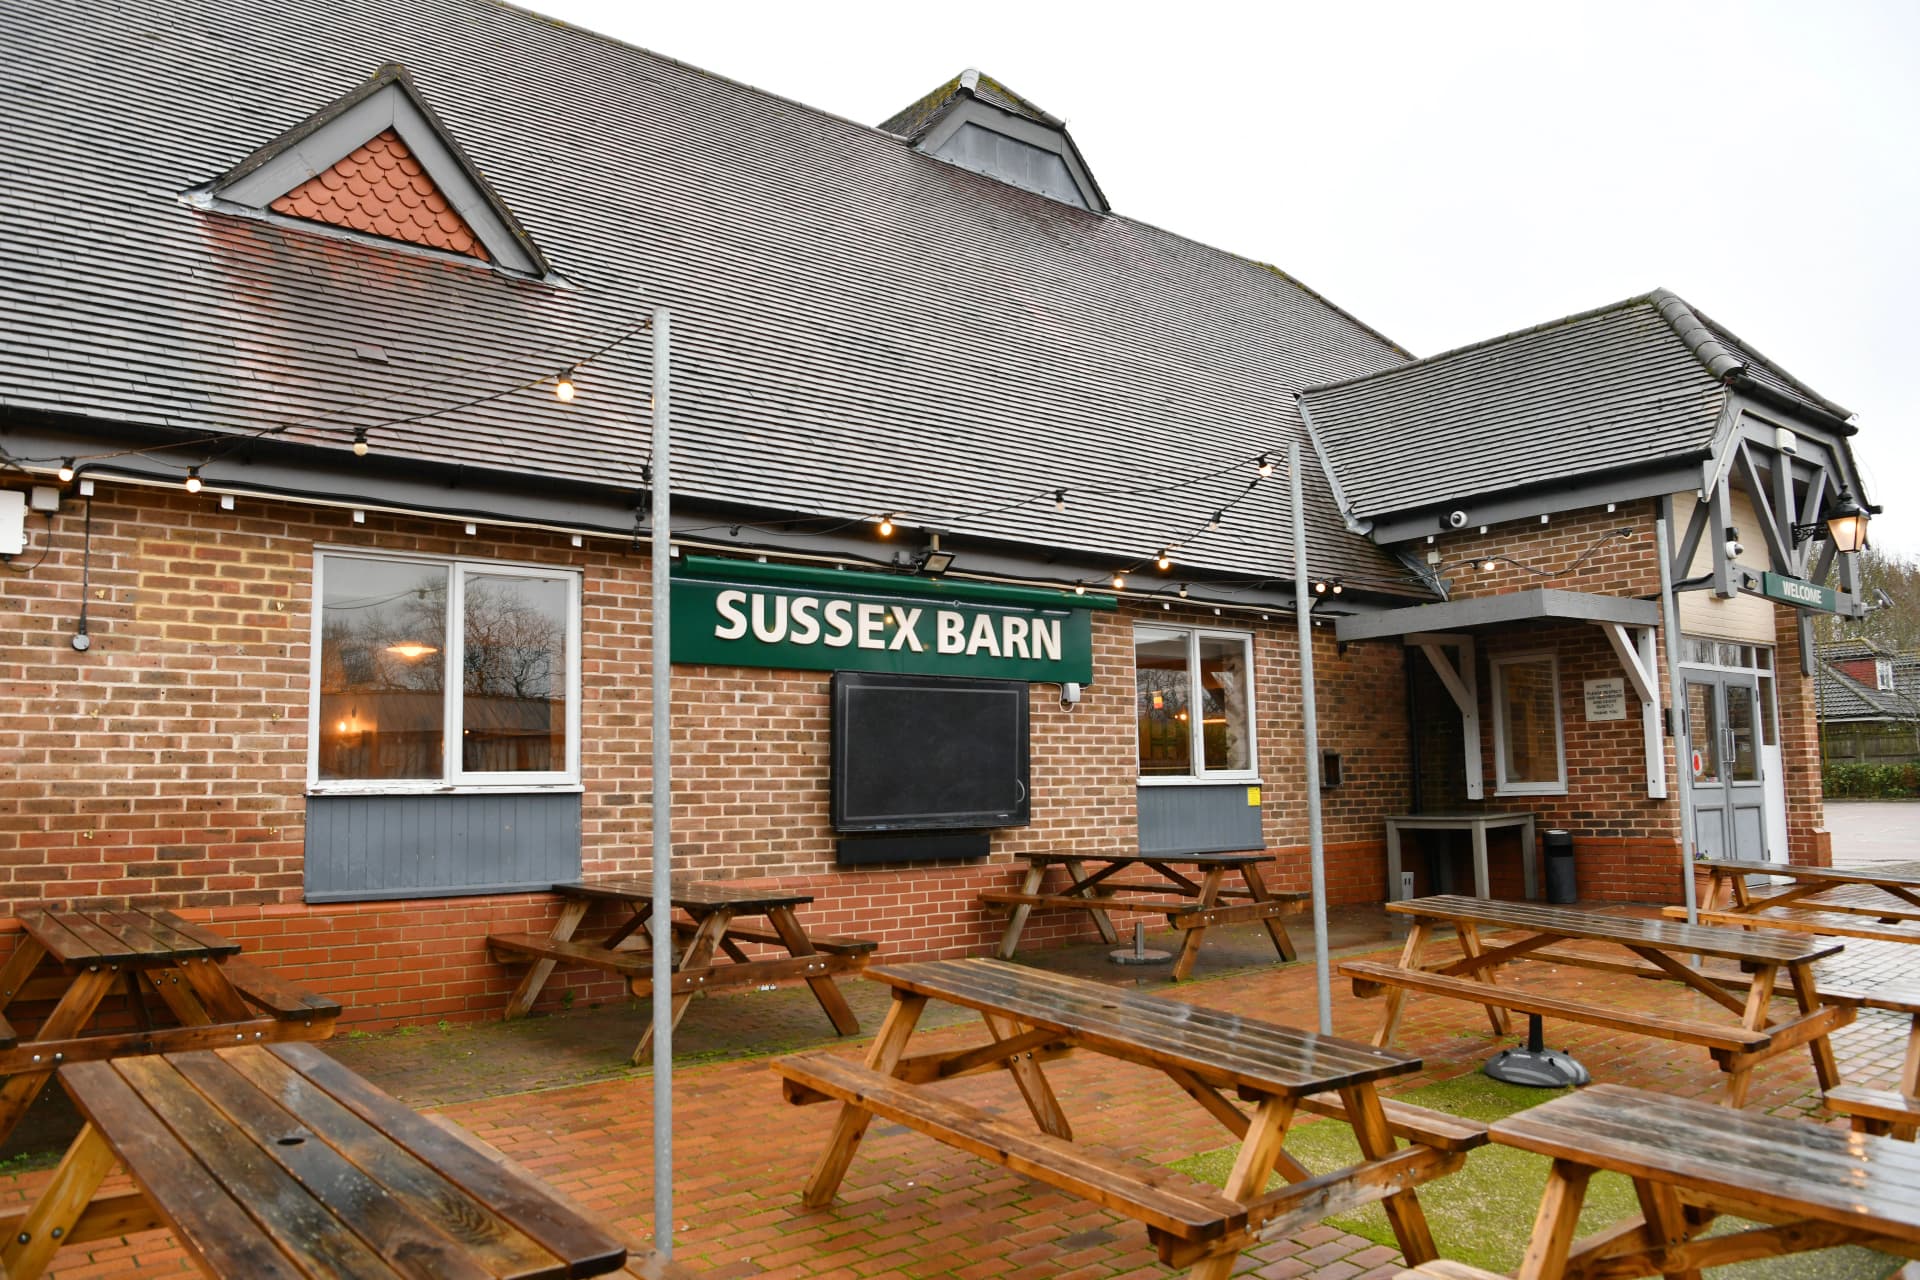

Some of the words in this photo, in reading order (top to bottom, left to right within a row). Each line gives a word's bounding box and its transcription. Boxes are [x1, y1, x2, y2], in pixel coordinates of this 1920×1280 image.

[1782, 580, 1823, 604] WELCOME
[714, 590, 923, 653] SUSSEX
[936, 610, 1062, 661] BARN
